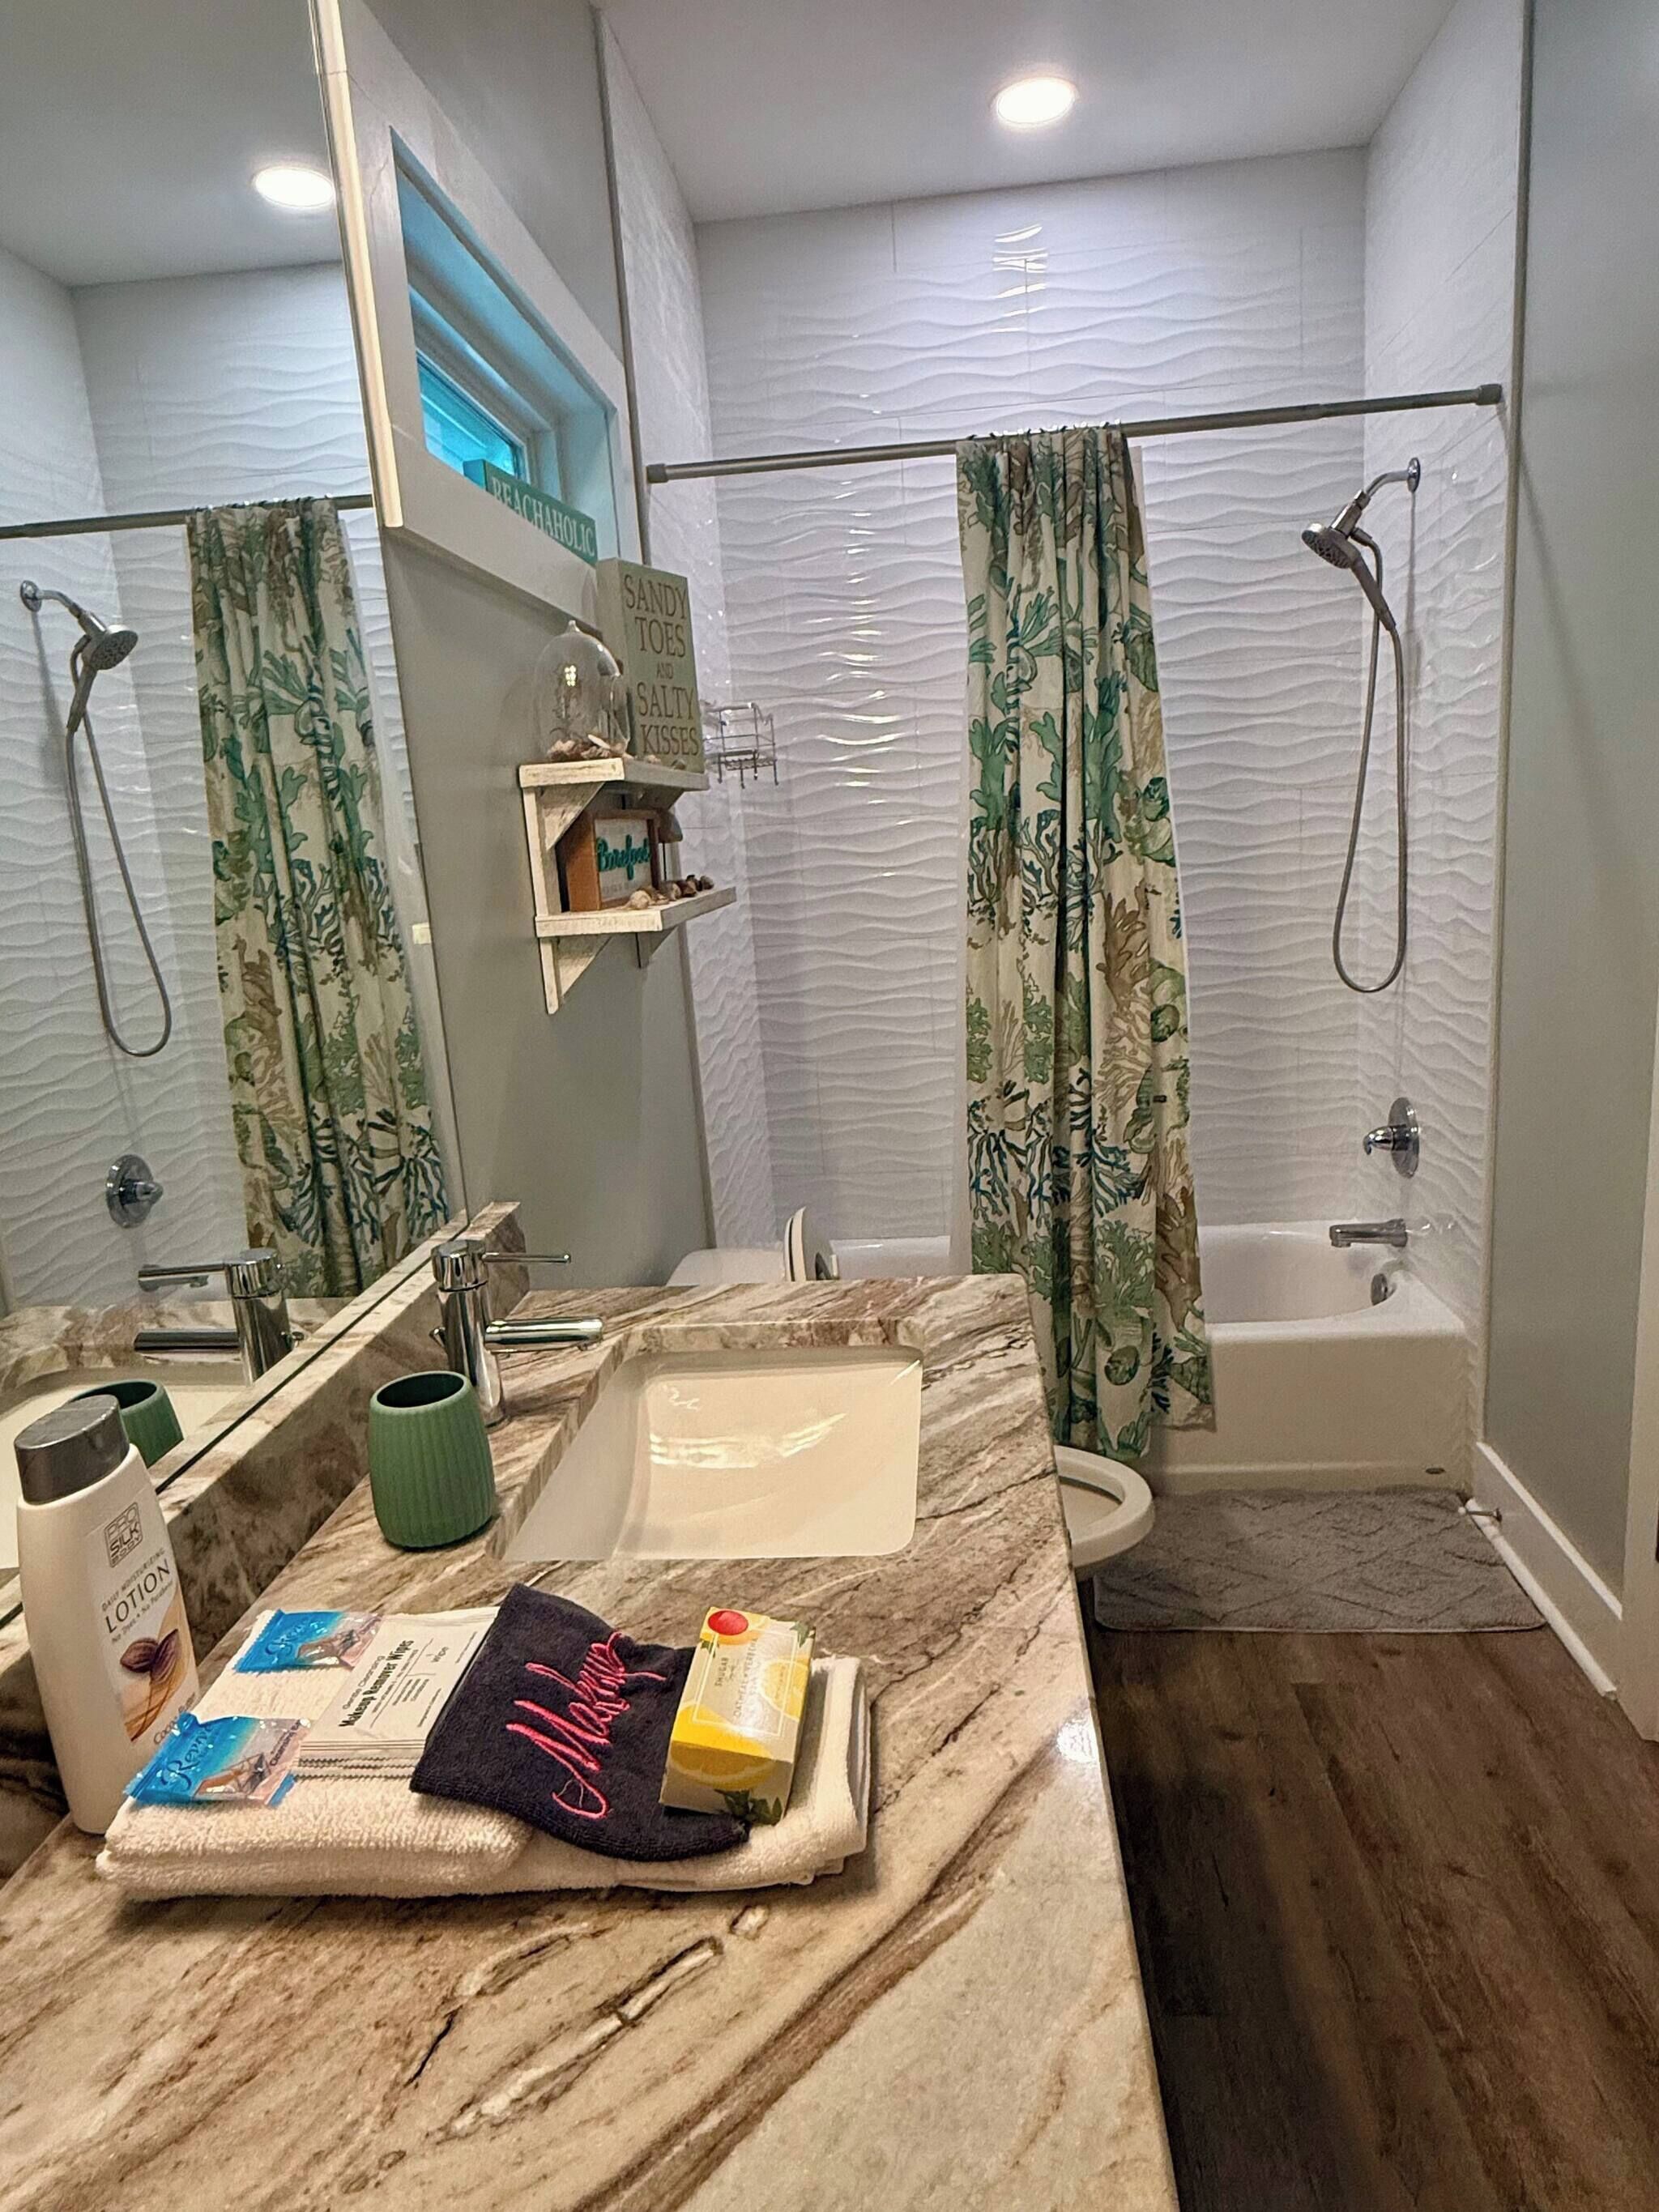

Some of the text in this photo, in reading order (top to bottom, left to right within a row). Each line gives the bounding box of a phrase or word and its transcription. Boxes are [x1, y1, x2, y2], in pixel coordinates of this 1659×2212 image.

[492, 477, 595, 557] BEACHAHOLIC
[624, 574, 689, 620] SANDY
[634, 616, 687, 658] TOES
[656, 663, 674, 680] AND
[637, 682, 697, 721] SALTY
[640, 726, 699, 757] KISSES
[108, 1507, 138, 1537] PRO
[110, 1522, 140, 1558] SILK
[112, 1537, 141, 1565] BODY
[105, 1558, 171, 1633] LOTION
[338, 1696, 377, 1727] Makeup
[362, 1662, 398, 1695] Remover
[386, 1639, 415, 1661] Wipes
[506, 1631, 667, 1820] Makeup
